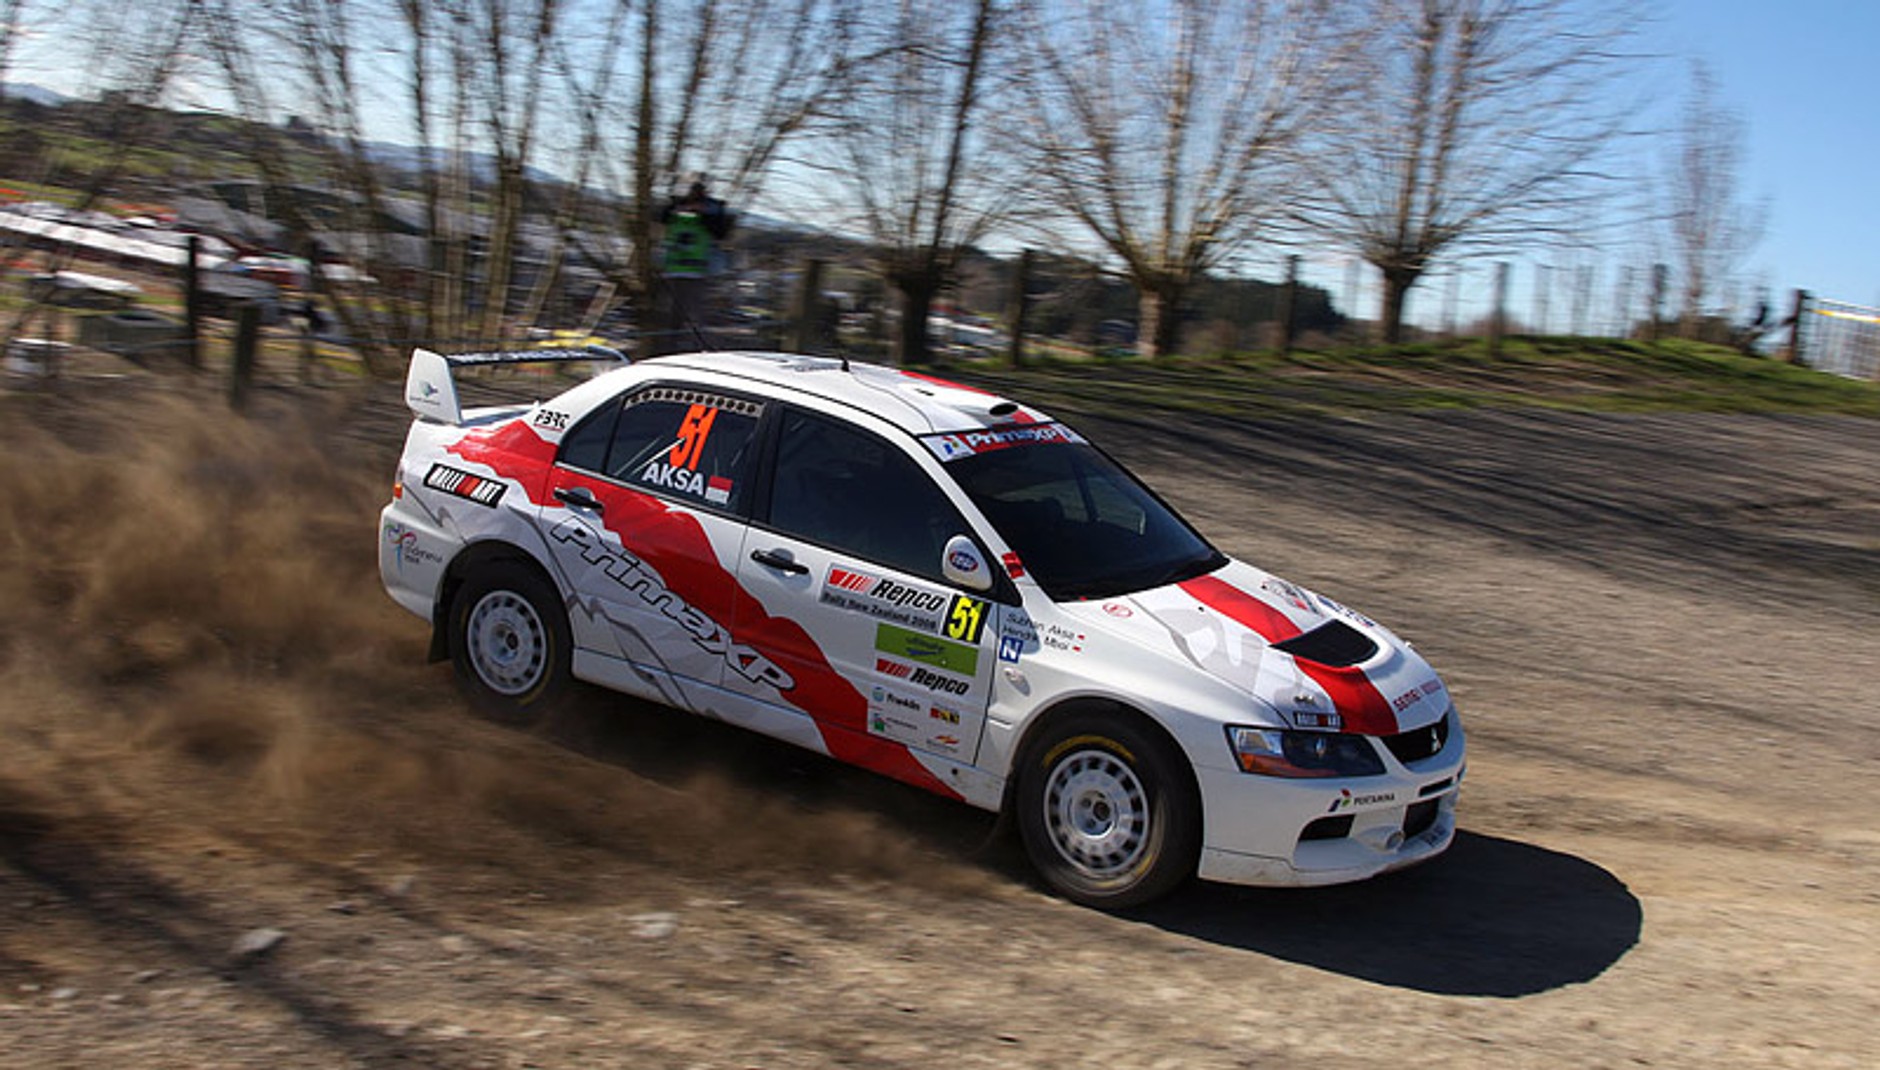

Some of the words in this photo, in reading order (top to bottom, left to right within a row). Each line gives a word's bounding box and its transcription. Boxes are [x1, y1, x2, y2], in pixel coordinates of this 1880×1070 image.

[669, 403, 719, 472] 51
[642, 462, 705, 496] AKSA
[870, 578, 946, 612] Repco
[948, 596, 982, 642] 51
[1001, 640, 1022, 660] N
[909, 666, 970, 696] Repco
